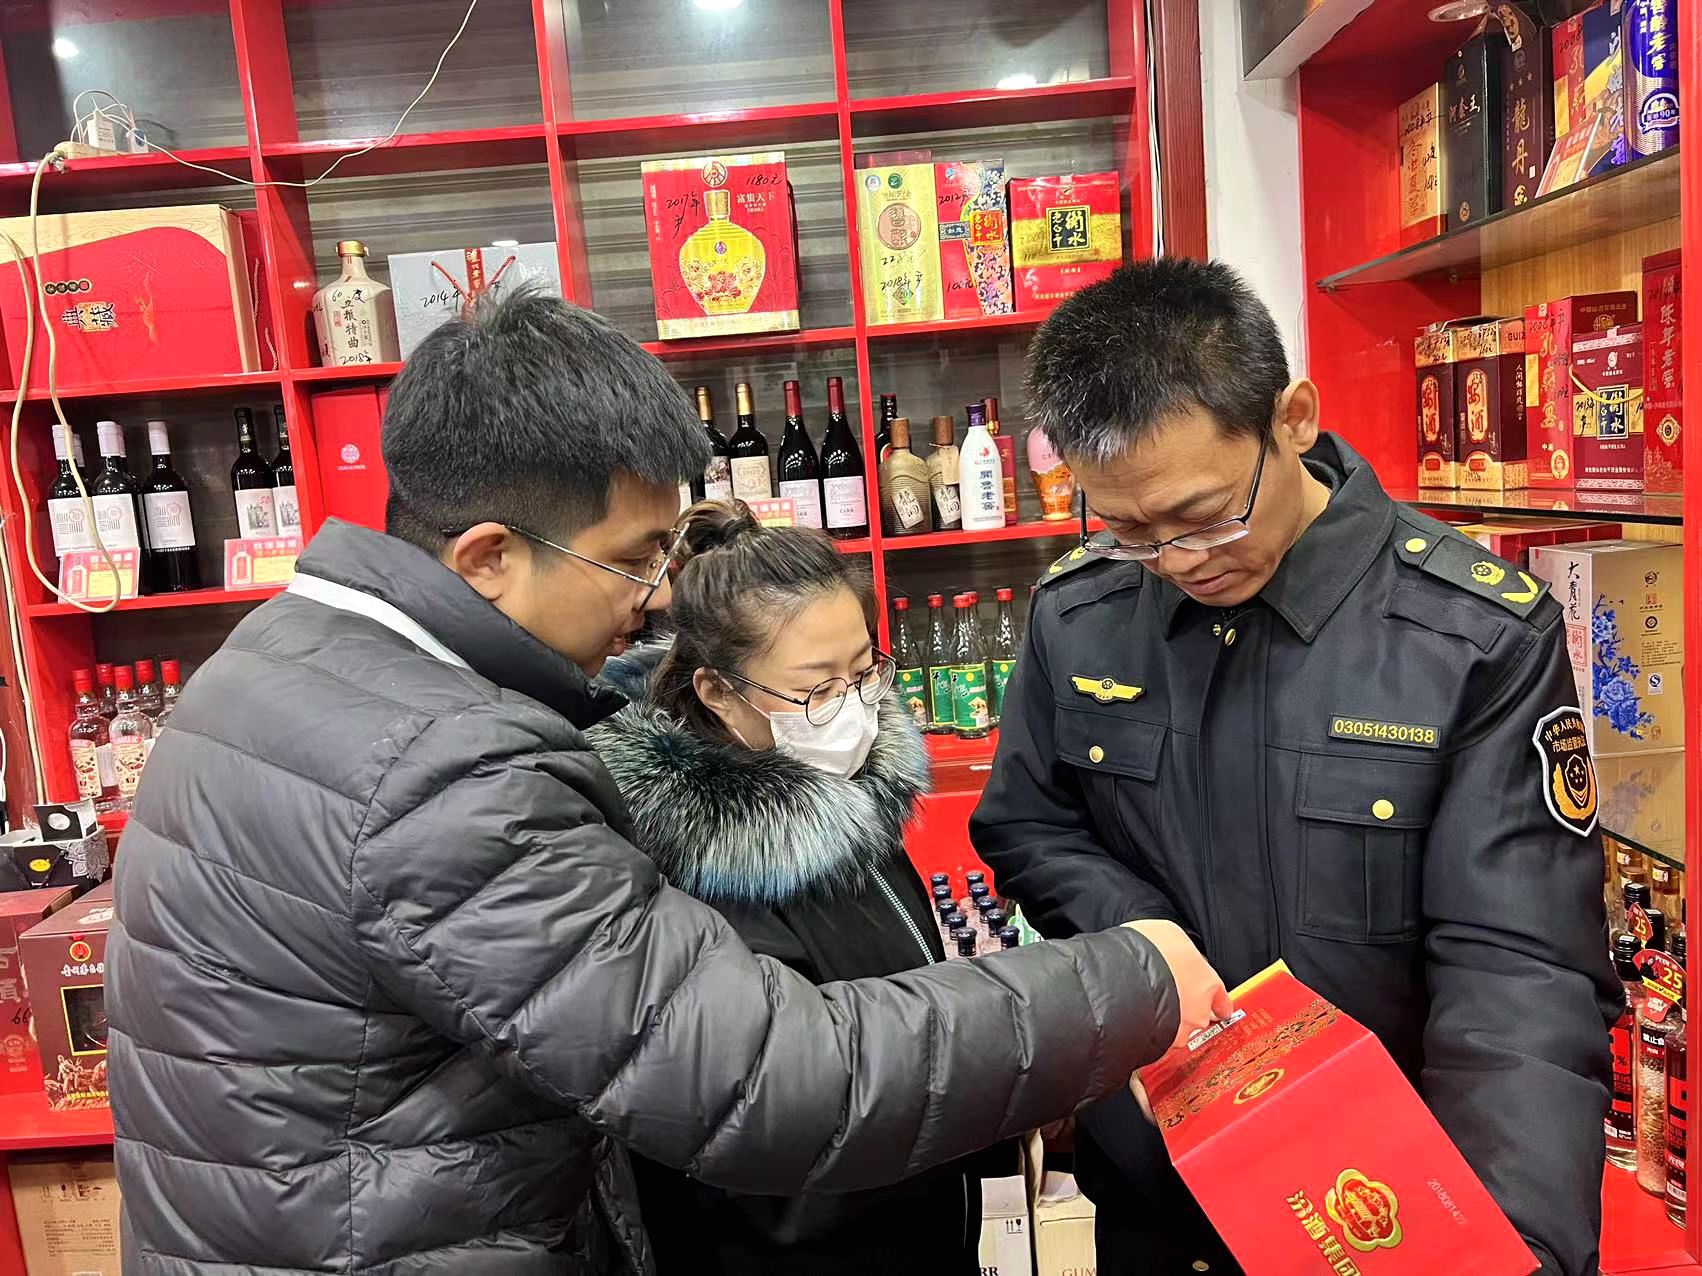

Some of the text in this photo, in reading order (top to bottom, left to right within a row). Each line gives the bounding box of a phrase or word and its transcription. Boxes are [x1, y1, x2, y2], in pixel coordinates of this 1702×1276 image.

[1567, 561, 1580, 621] 大青花
[1334, 719, 1435, 744] 03051430138
[1662, 966, 1683, 990] 25
